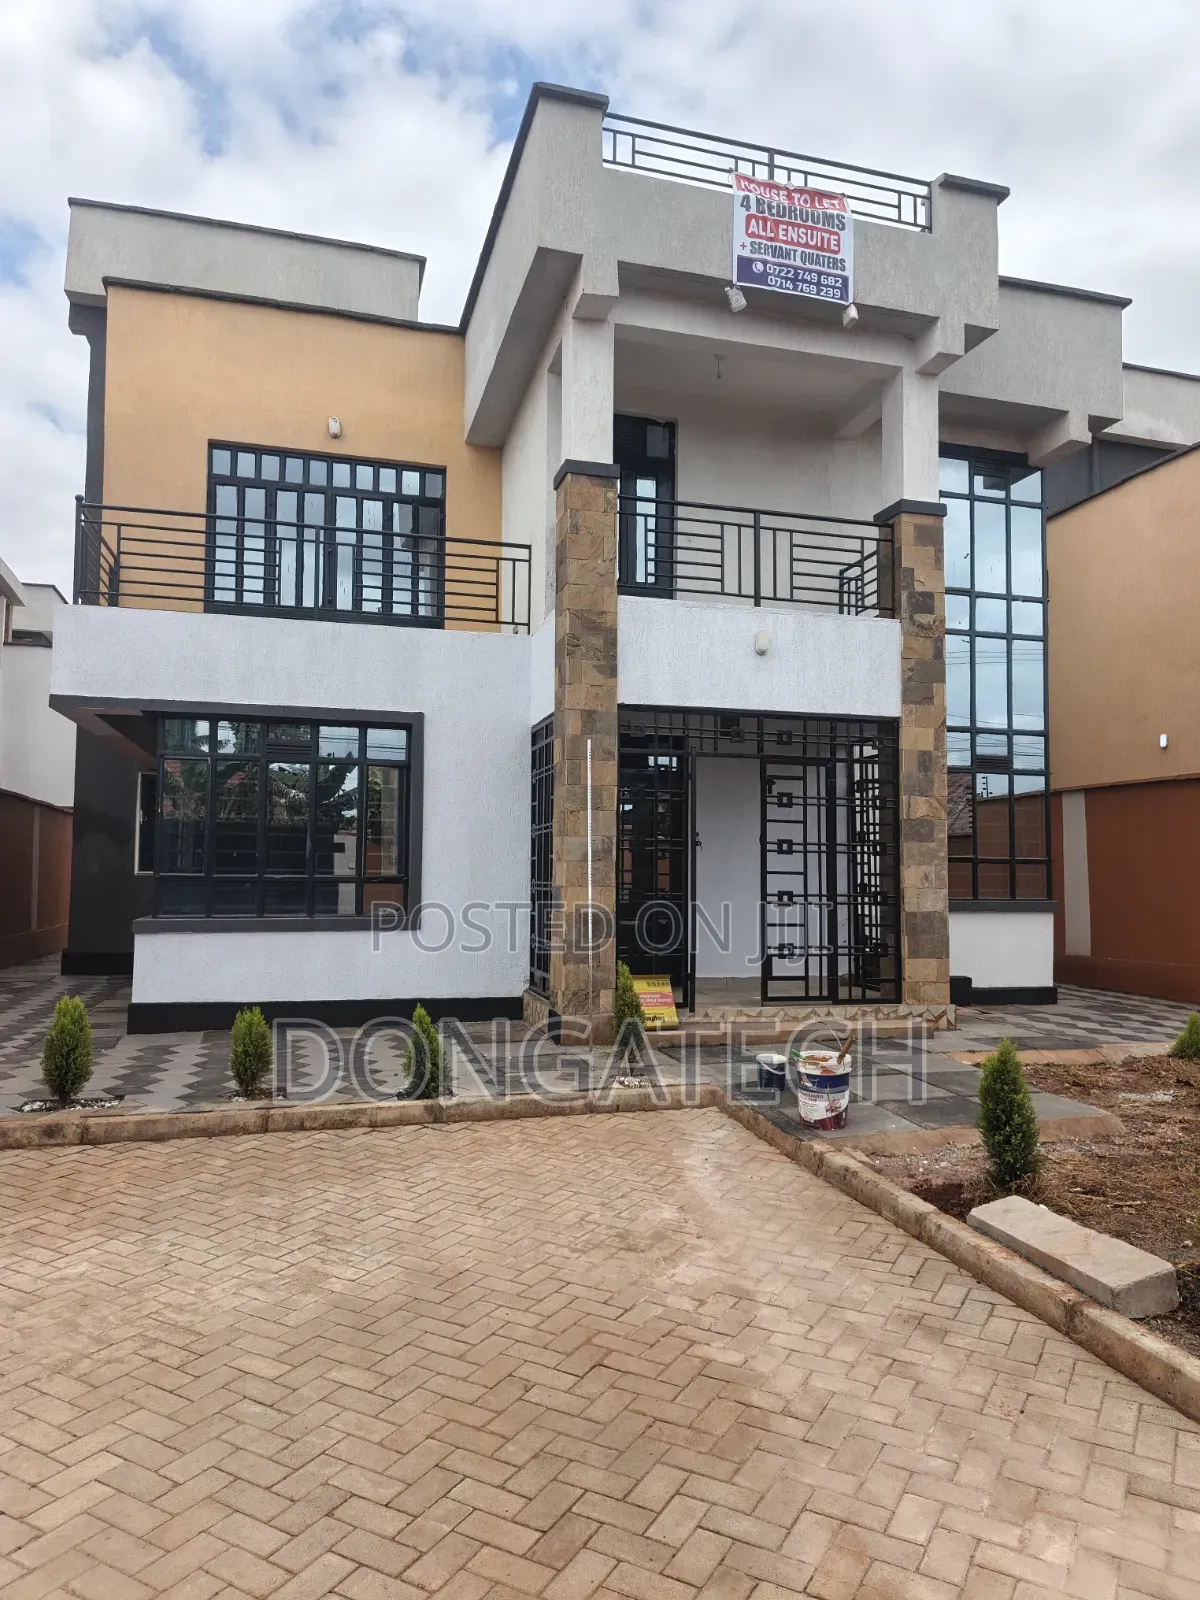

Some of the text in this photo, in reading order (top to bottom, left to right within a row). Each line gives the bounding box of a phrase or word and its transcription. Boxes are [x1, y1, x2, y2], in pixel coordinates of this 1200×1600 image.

[740, 179, 840, 209] HOUSE TO LET
[740, 194, 846, 232] 4 BEDROOMS
[748, 218, 839, 251] ALL ENSUITE
[749, 240, 799, 262] SERVANT
[800, 250, 846, 272] QUATERS
[766, 264, 843, 287] 0722 749 682
[767, 275, 841, 299] 0714 769 239
